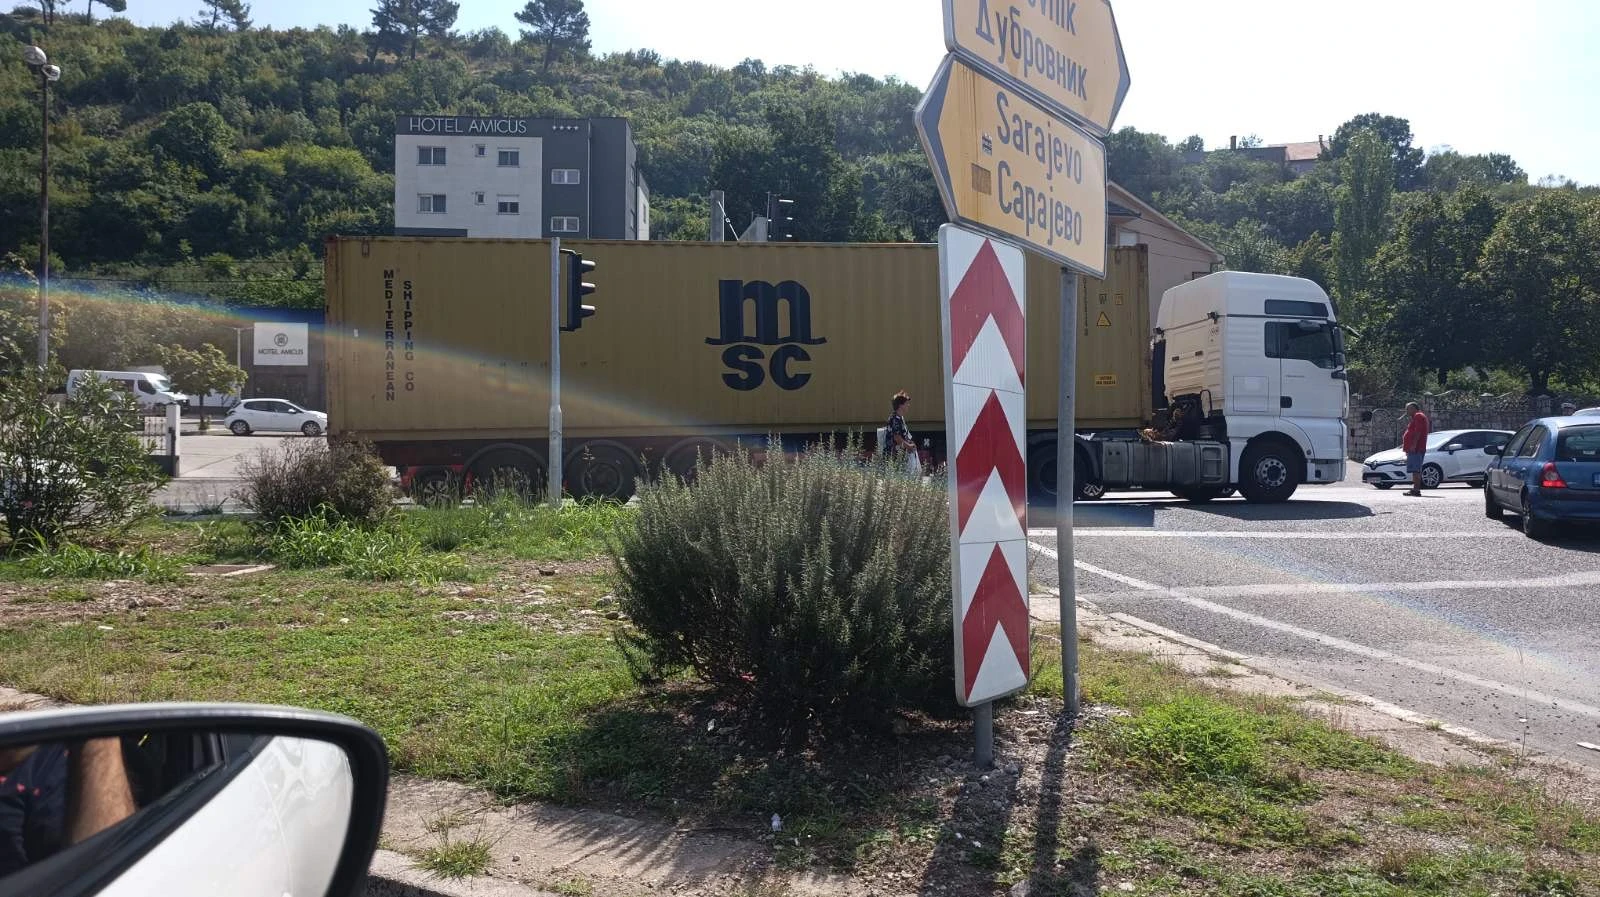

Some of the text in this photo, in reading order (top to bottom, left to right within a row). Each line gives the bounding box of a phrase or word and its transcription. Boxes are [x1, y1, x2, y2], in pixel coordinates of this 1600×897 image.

[975, 0, 1087, 101] Дубровник
[410, 118, 527, 133] HOTEL AMICUS
[996, 91, 1083, 184] Sarajevo
[997, 160, 1083, 246] Сарајево
[384, 269, 395, 401] MEDITERRANEAN
[403, 281, 414, 391] SHIPPING CO
